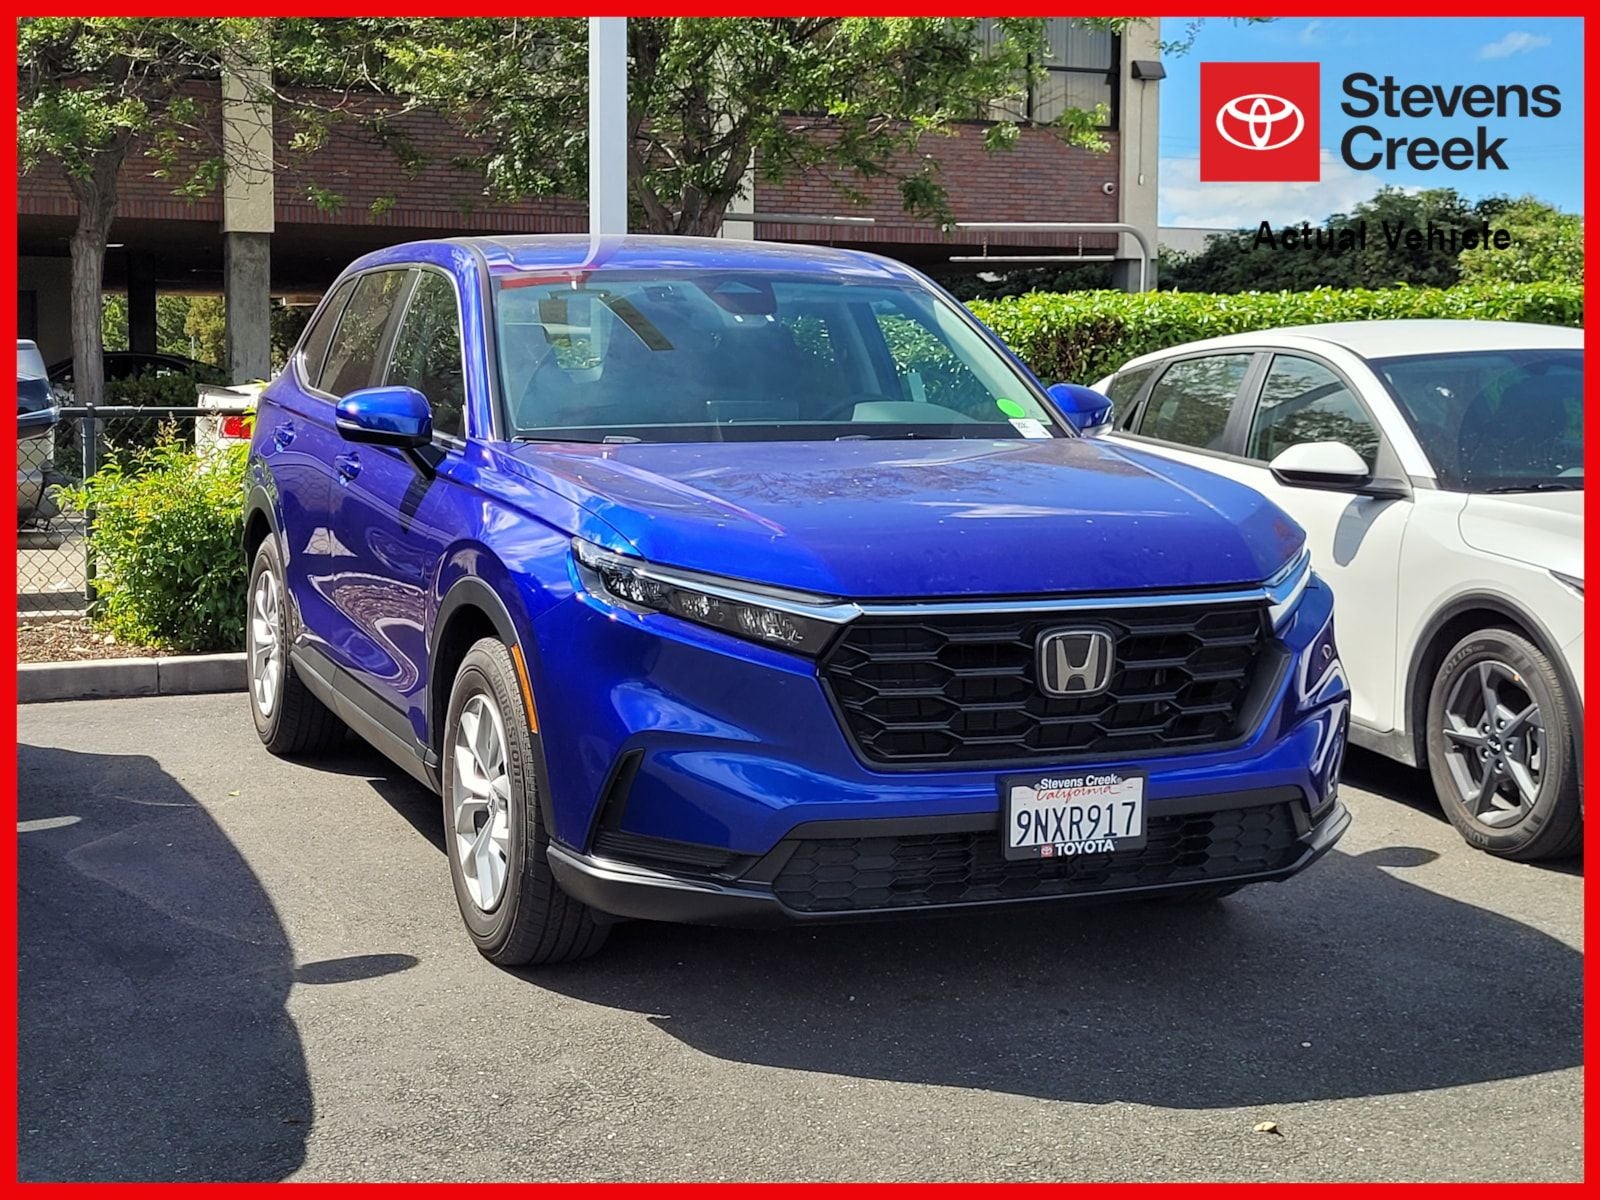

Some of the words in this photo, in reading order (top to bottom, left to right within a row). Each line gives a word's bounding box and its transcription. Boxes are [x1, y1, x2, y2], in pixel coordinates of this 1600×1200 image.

[1040, 777, 1083, 790] Stevens
[1085, 773, 1118, 786] Creek
[1036, 785, 1121, 803] California
[1016, 801, 1136, 846] 9NXR917
[1055, 838, 1115, 856] TOYOTA
